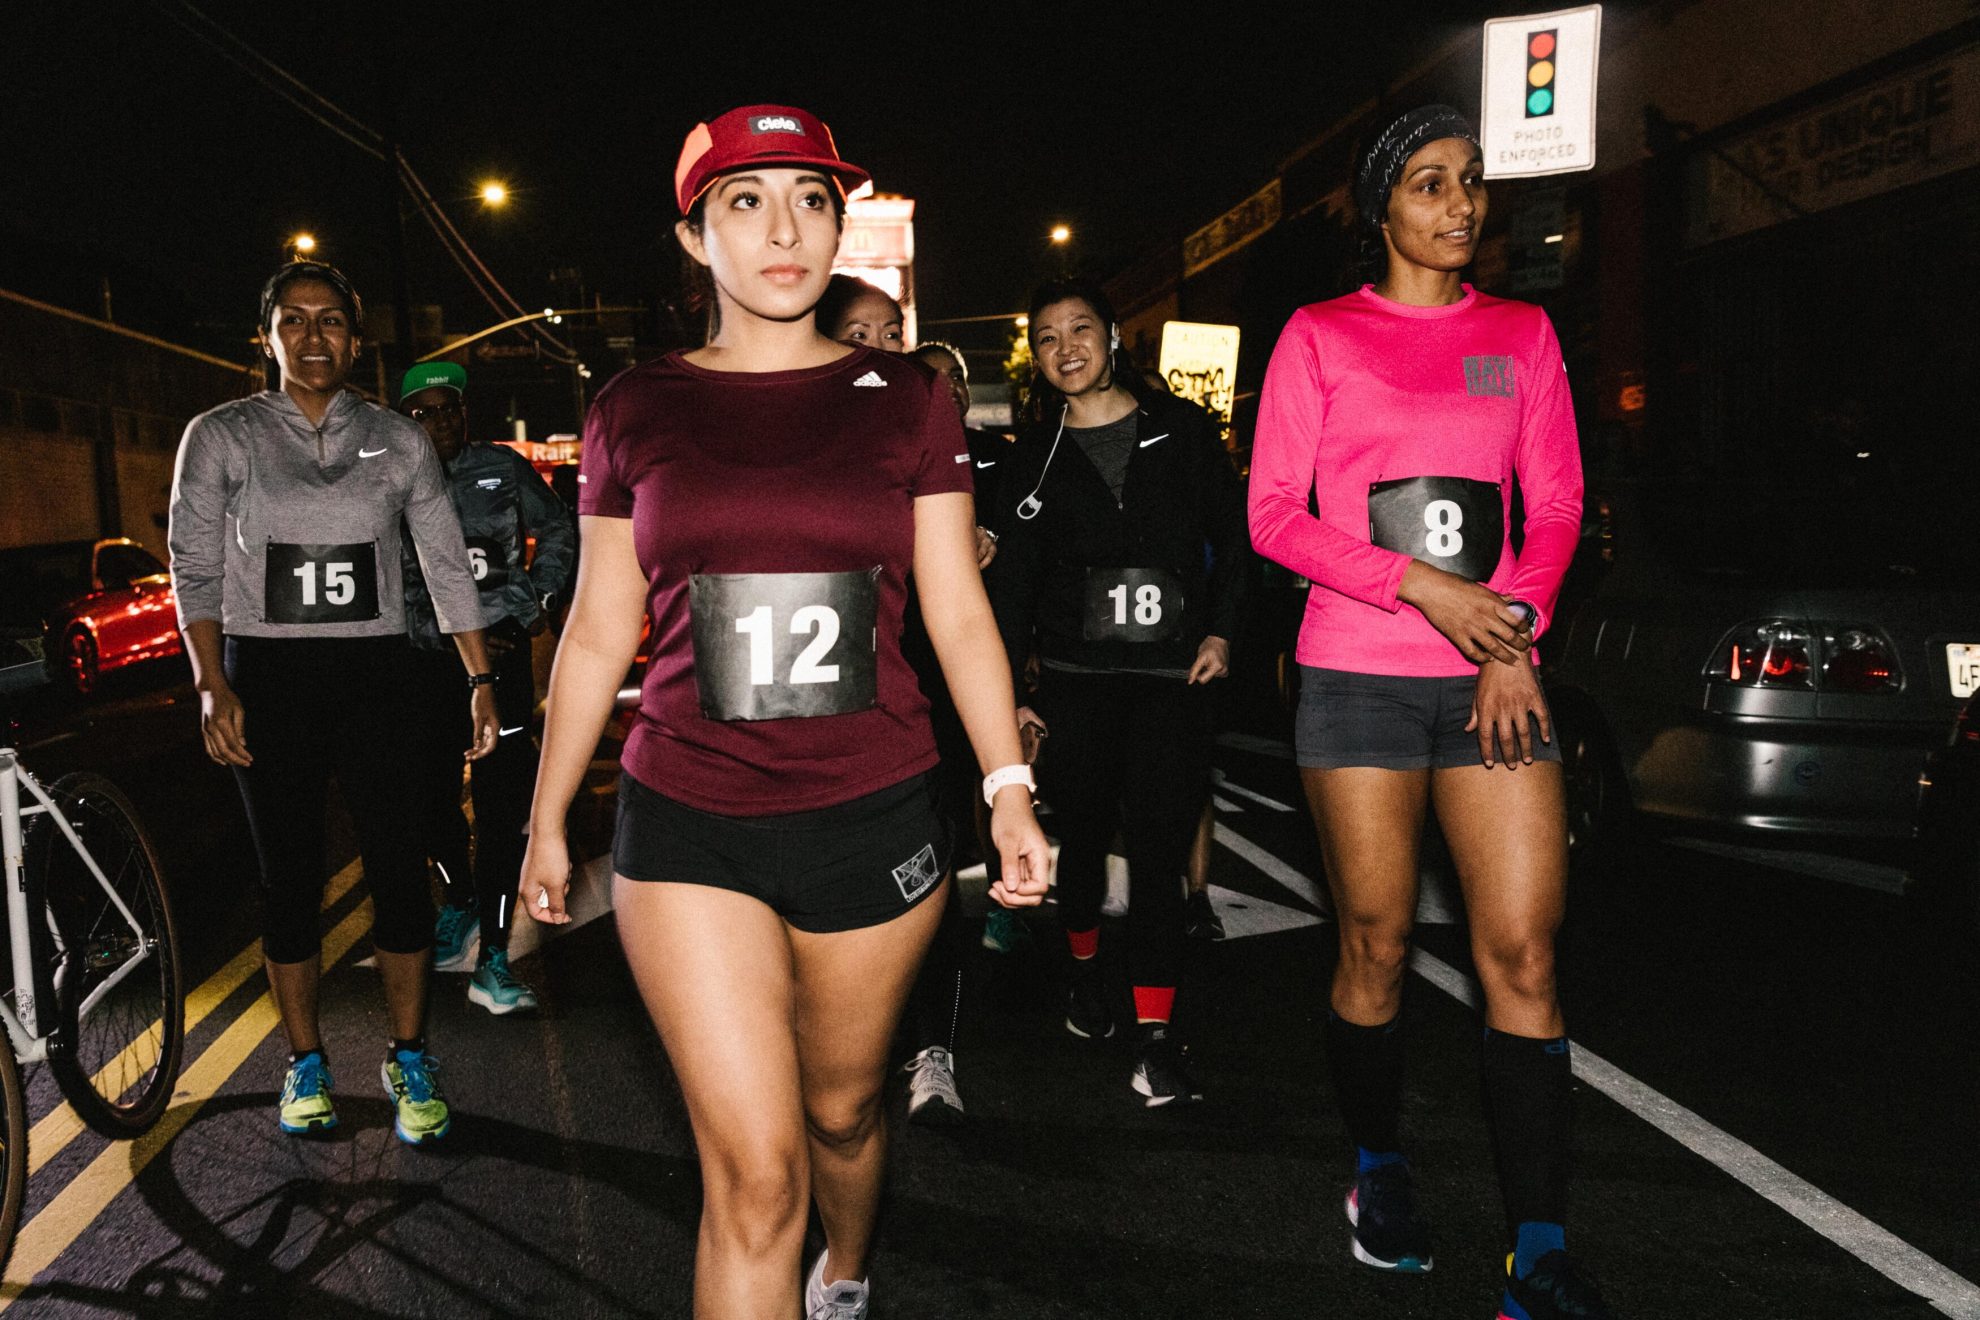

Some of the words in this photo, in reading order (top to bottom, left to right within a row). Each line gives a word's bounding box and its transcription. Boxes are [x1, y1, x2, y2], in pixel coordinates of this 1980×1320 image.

[1513, 126, 1564, 143] PHOTO
[1799, 68, 1954, 160] UNIQUE
[1499, 144, 1577, 163] ENFORCED
[1423, 499, 1463, 557] 8
[292, 561, 356, 606] 15
[1107, 584, 1162, 626] 18
[734, 604, 841, 686] 12
